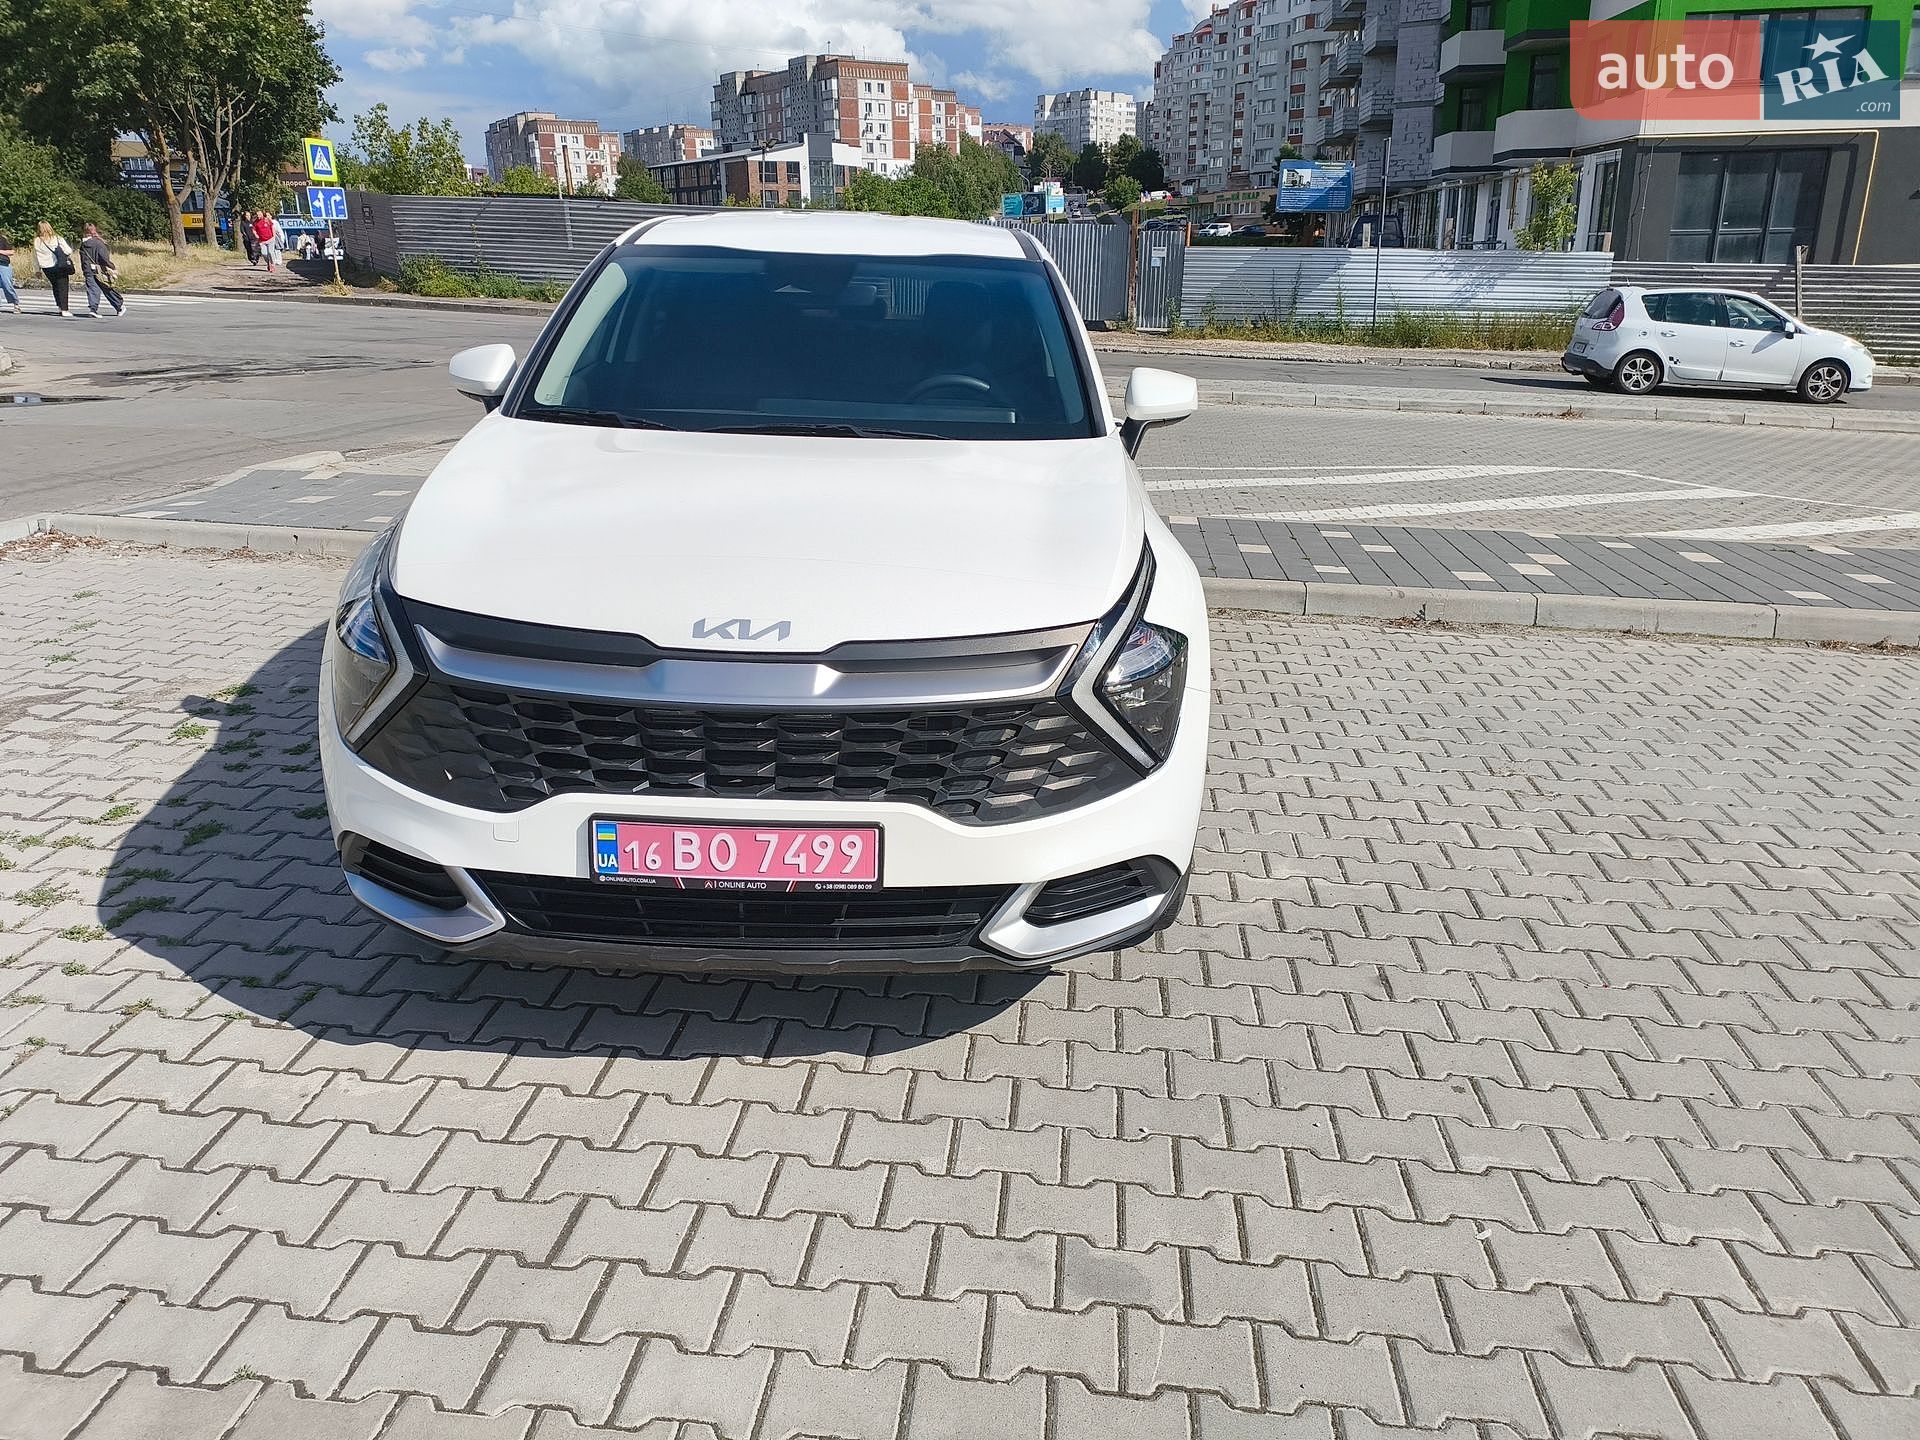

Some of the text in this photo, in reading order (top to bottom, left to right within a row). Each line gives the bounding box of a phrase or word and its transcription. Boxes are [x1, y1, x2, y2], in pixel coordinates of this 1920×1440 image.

[691, 618, 792, 642] KIA
[598, 853, 618, 868] UA
[623, 831, 864, 875] 16 BO 7499
[718, 881, 746, 889] ONLINE
